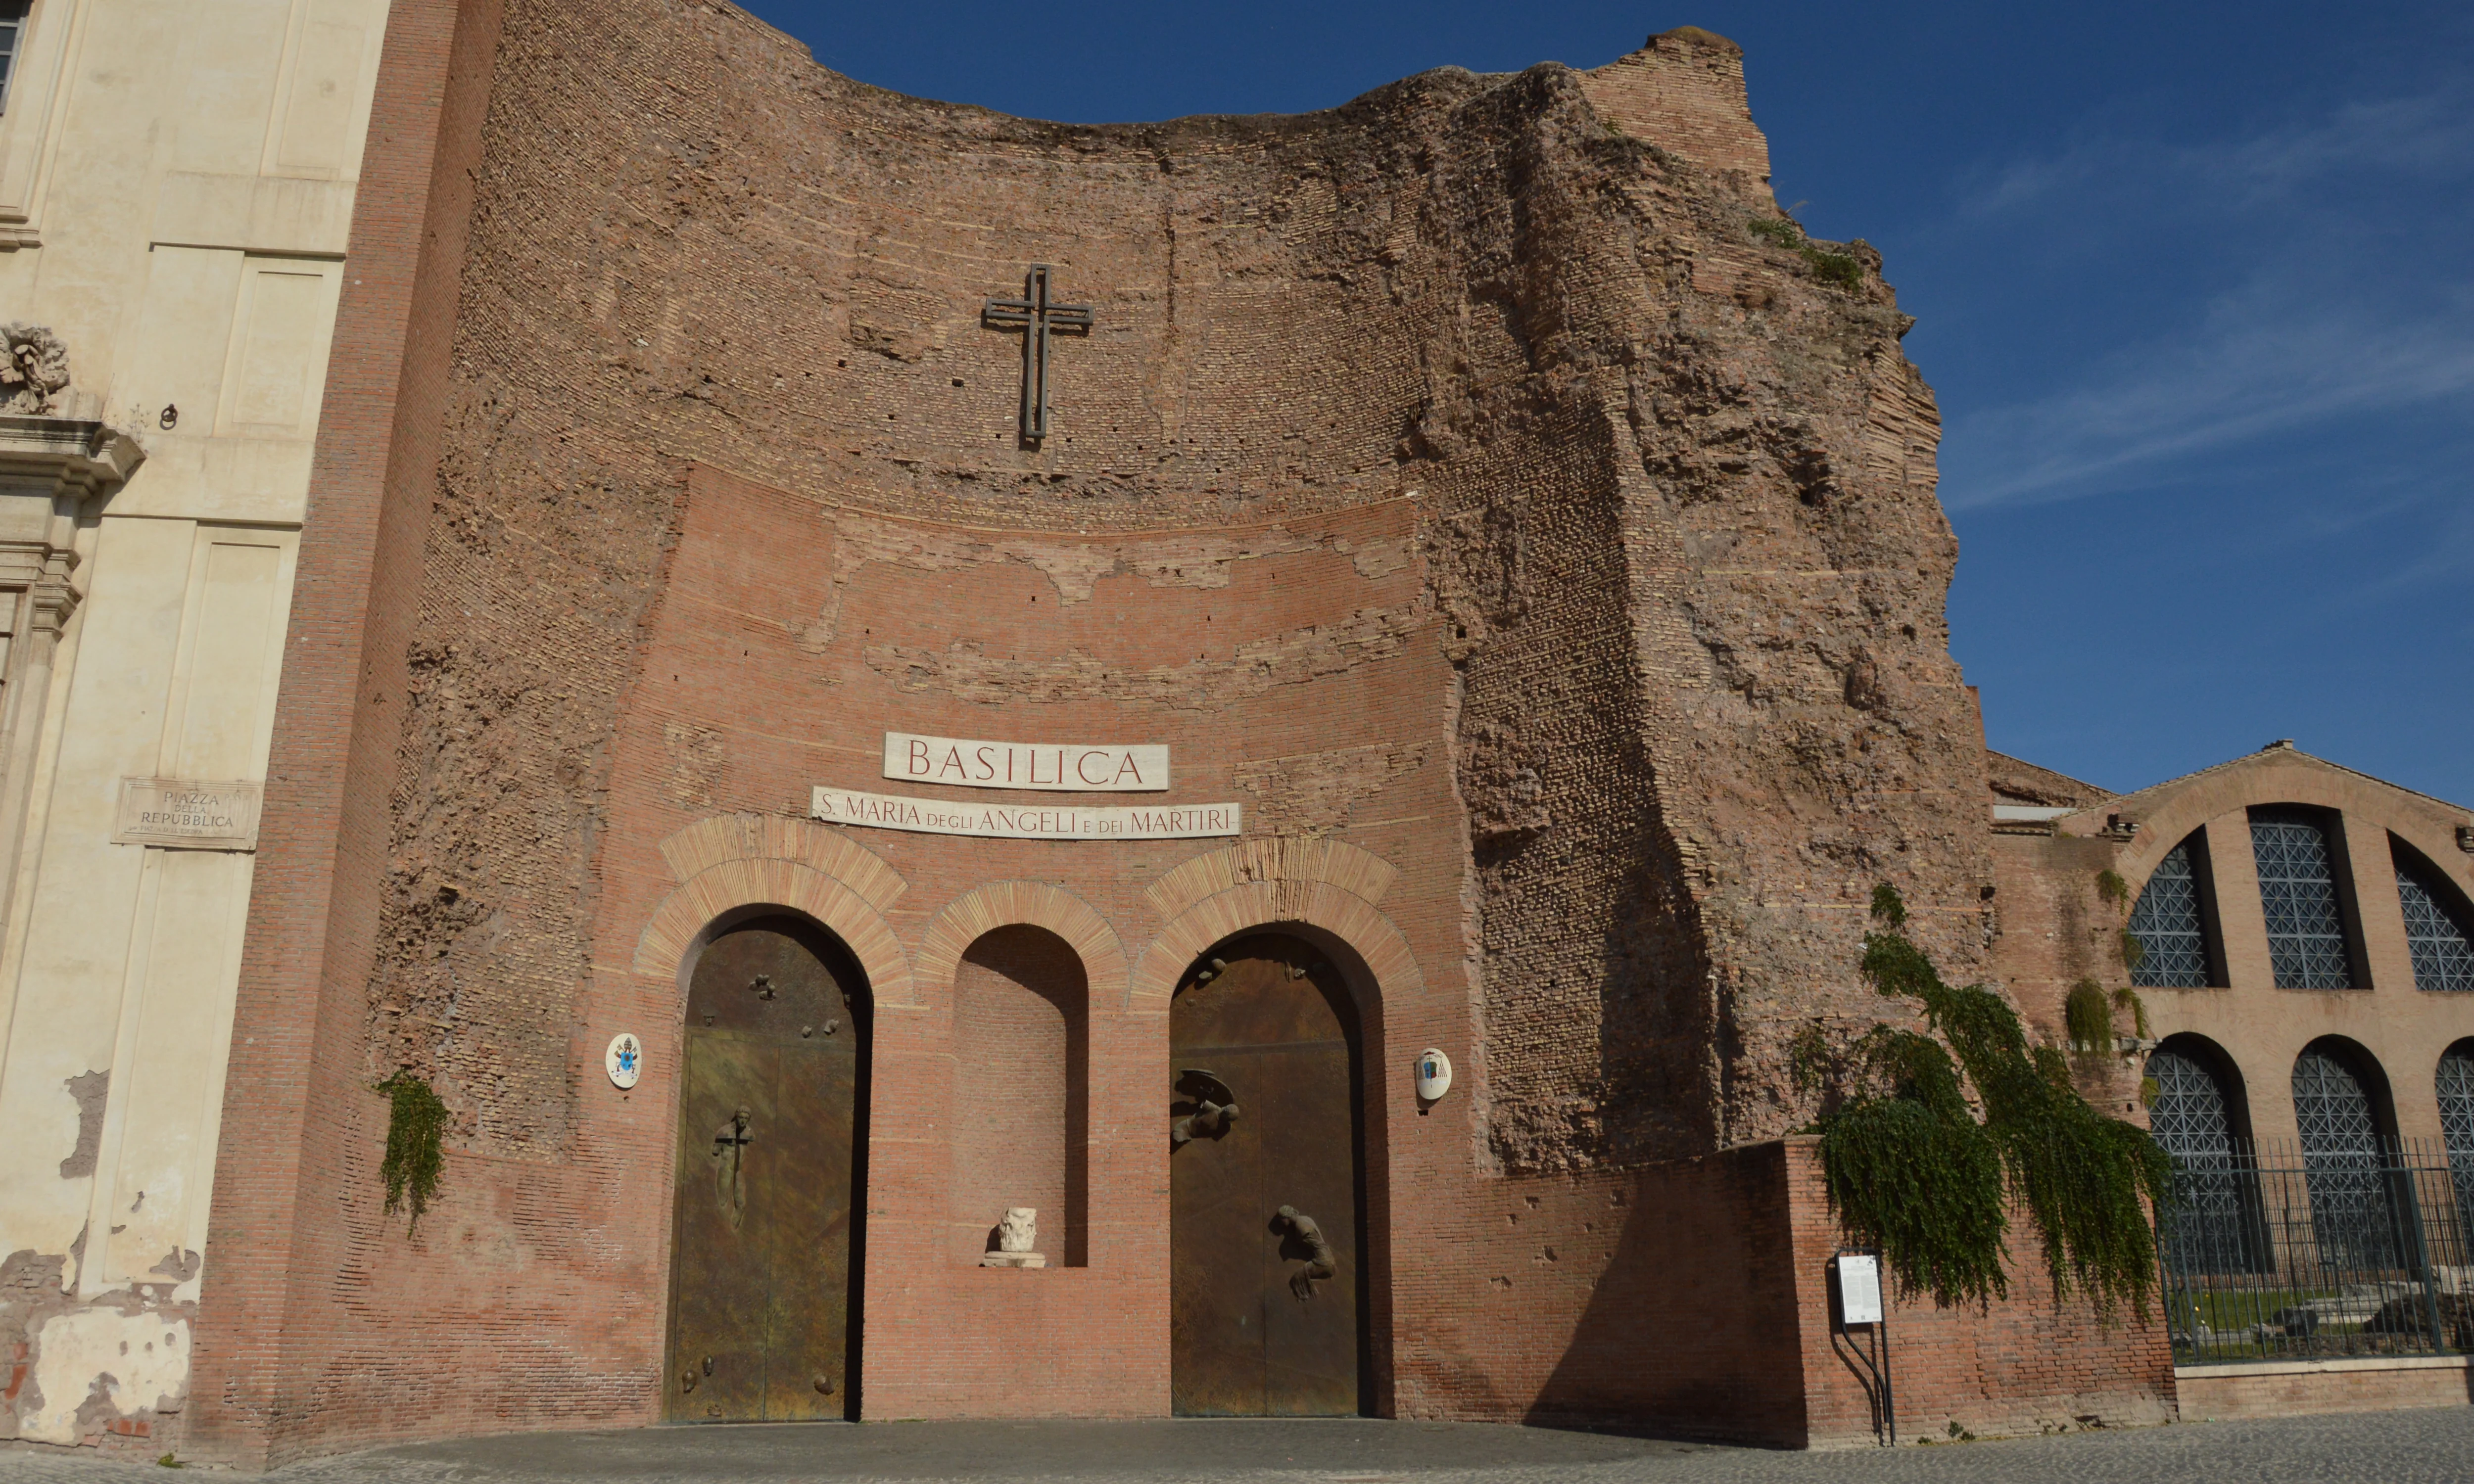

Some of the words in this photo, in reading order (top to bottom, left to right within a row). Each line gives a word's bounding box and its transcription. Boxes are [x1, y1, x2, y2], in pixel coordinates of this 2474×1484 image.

[908, 740, 1144, 785] BASILICA
[164, 791, 219, 805] PIAZZA
[175, 804, 206, 814] DELLA
[821, 794, 836, 815] S.
[846, 796, 920, 825] MARIA
[927, 813, 972, 829] DEGLI
[978, 810, 1076, 833] ANGELI
[1083, 820, 1091, 833] E
[1099, 820, 1123, 834] DEI
[1132, 809, 1230, 833] MARTIRI
[141, 812, 234, 828] REPUBBLICA
